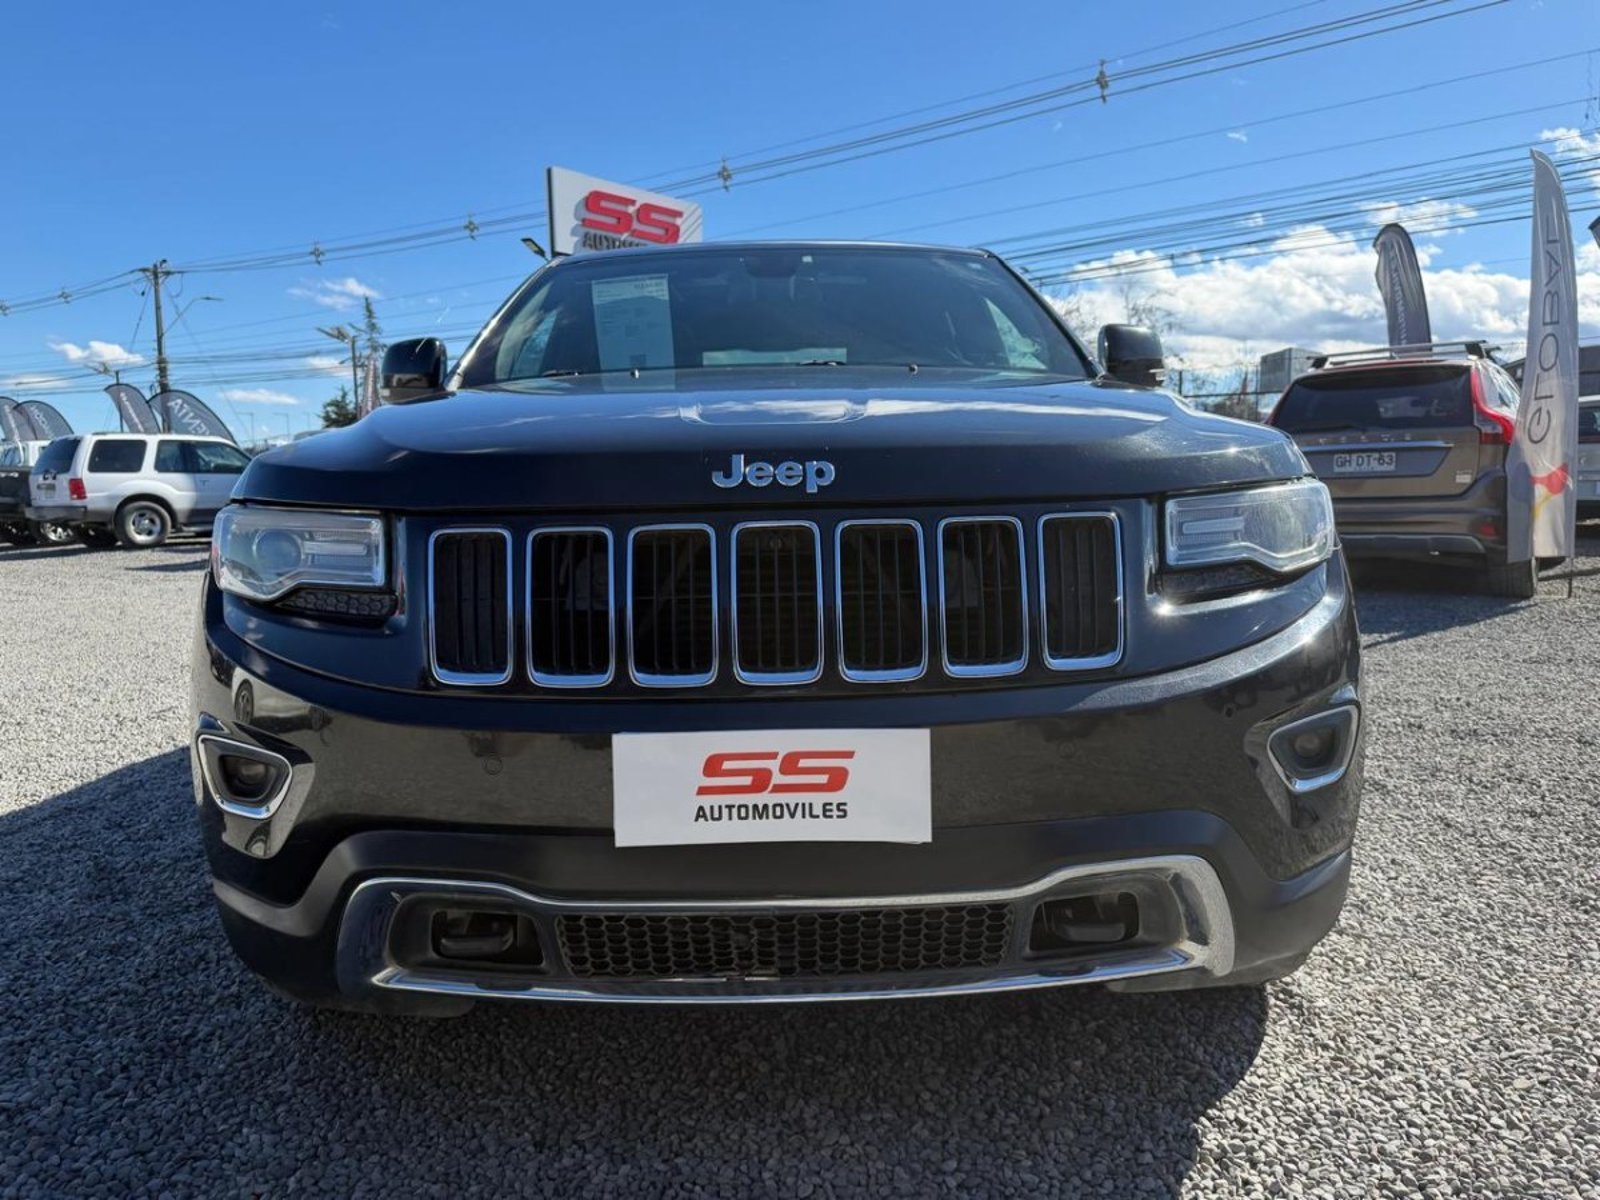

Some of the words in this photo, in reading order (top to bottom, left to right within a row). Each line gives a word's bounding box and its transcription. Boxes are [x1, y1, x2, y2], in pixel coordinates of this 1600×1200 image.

[582, 190, 683, 245] SS
[711, 453, 836, 494] Jeep
[695, 750, 856, 795] SS
[694, 802, 848, 822] AUTOMOVILES
